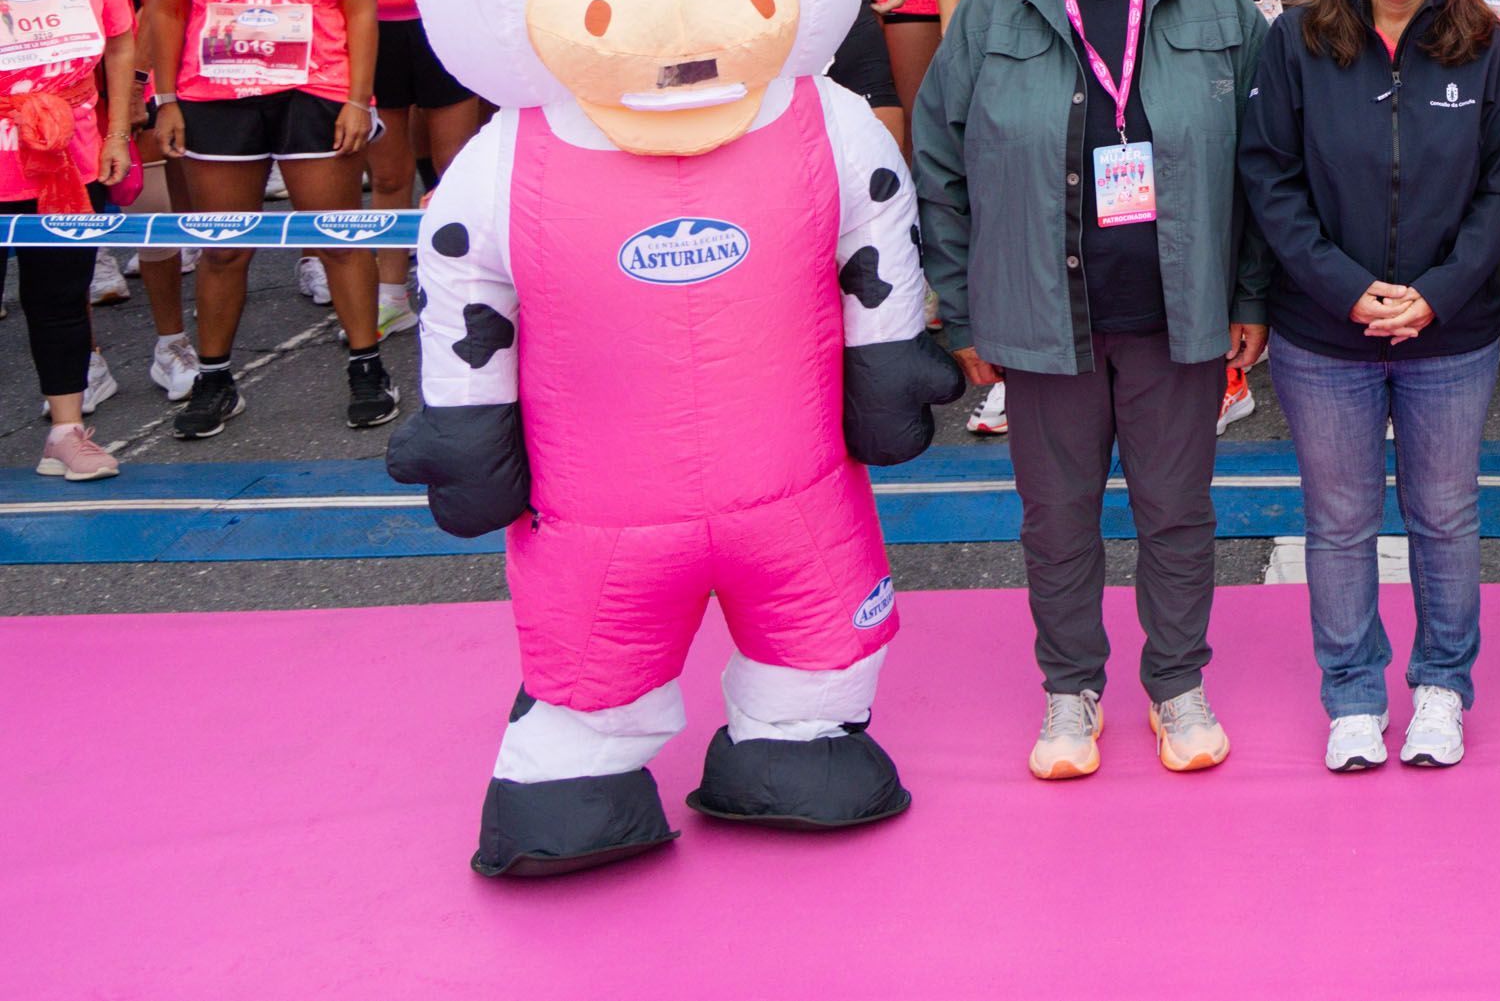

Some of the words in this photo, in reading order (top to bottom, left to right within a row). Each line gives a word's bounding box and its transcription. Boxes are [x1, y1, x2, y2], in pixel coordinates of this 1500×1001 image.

[18, 14, 60, 31] 016
[234, 40, 275, 56] 016
[1102, 212, 1152, 225] PATROCINADOR
[630, 242, 740, 269] ASTURIANA
